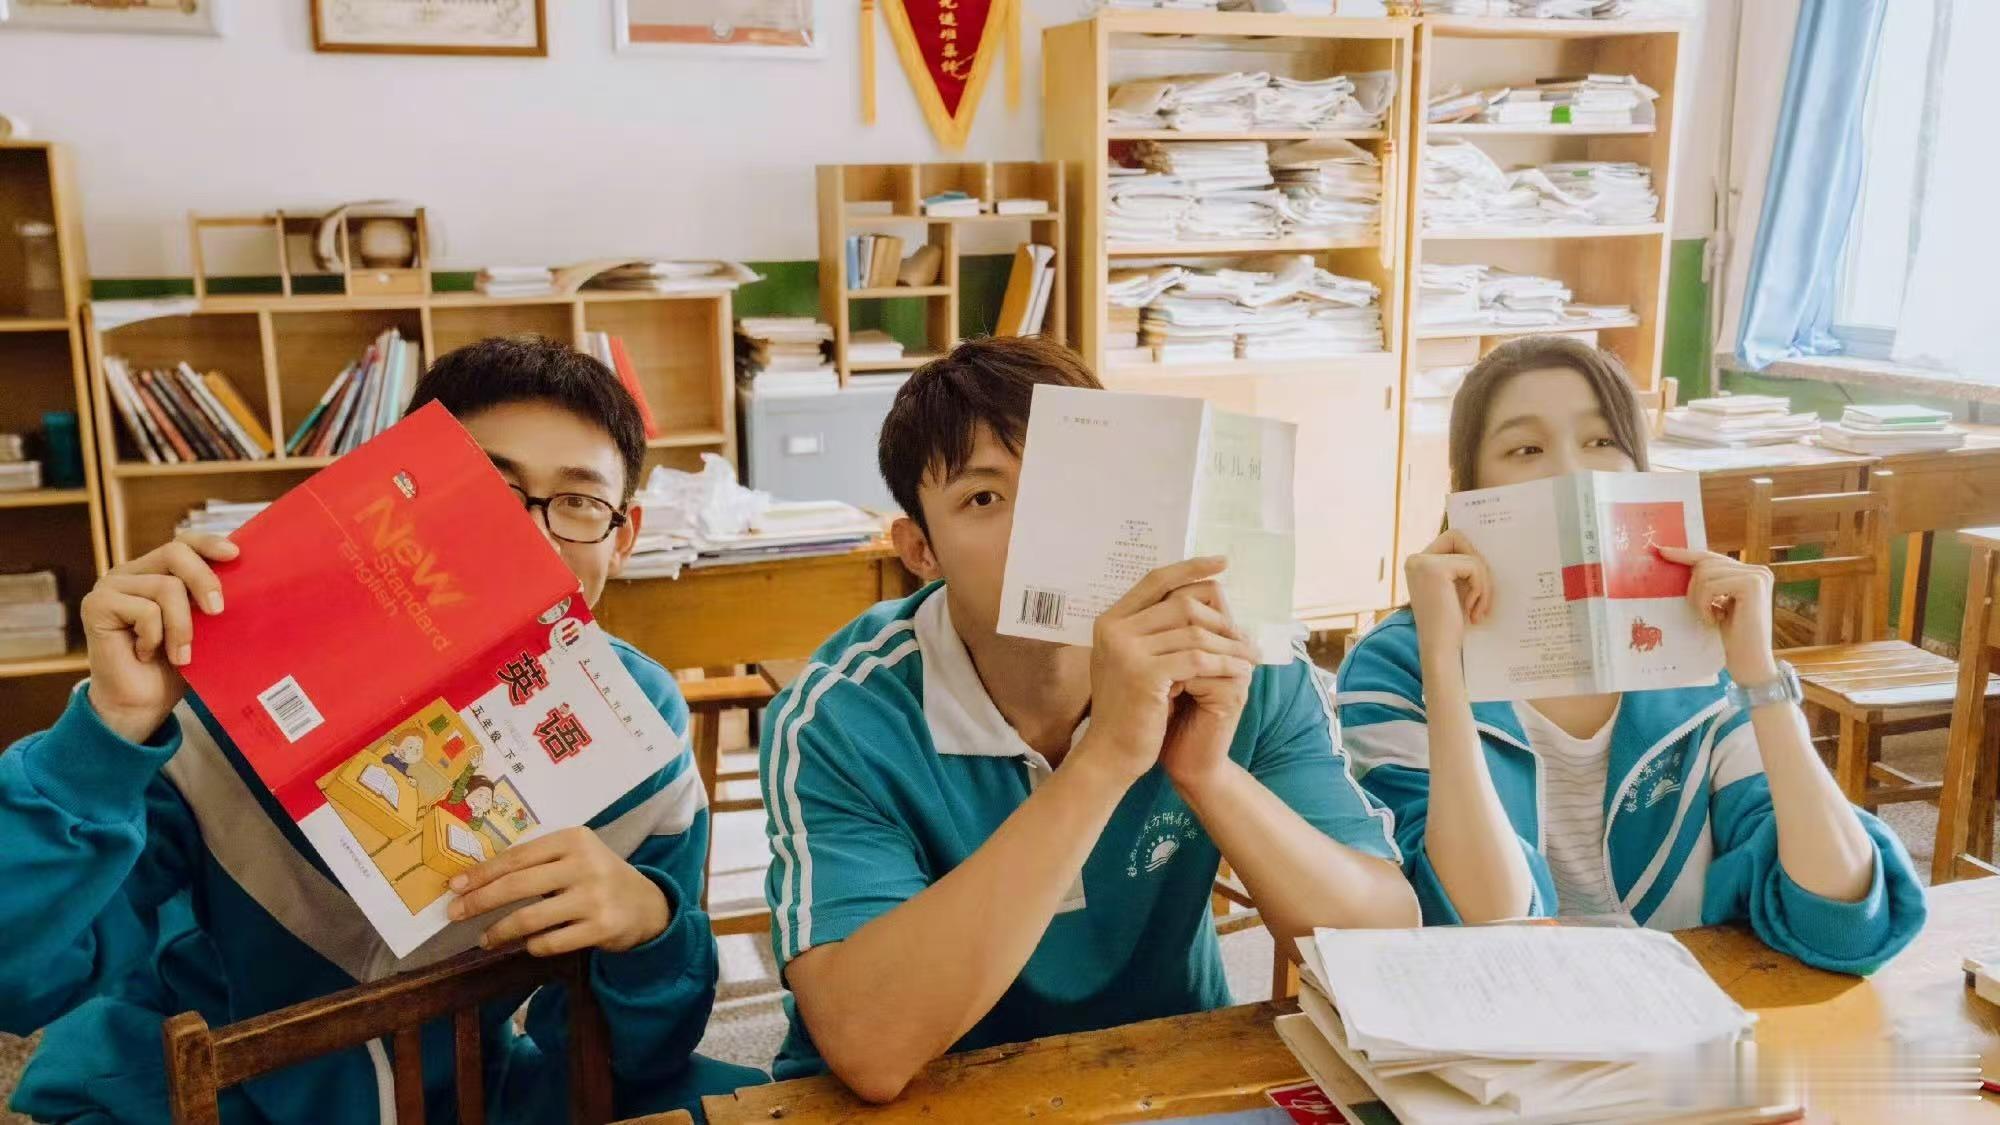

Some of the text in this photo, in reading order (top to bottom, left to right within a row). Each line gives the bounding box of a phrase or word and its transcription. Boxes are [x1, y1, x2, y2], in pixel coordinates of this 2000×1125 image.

[340, 538, 400, 620] English
[356, 497, 470, 610] New
[373, 554, 452, 653] Standard
[469, 702, 502, 746] 五年级
[502, 749, 526, 776] 下册
[496, 651, 593, 765] 英语
